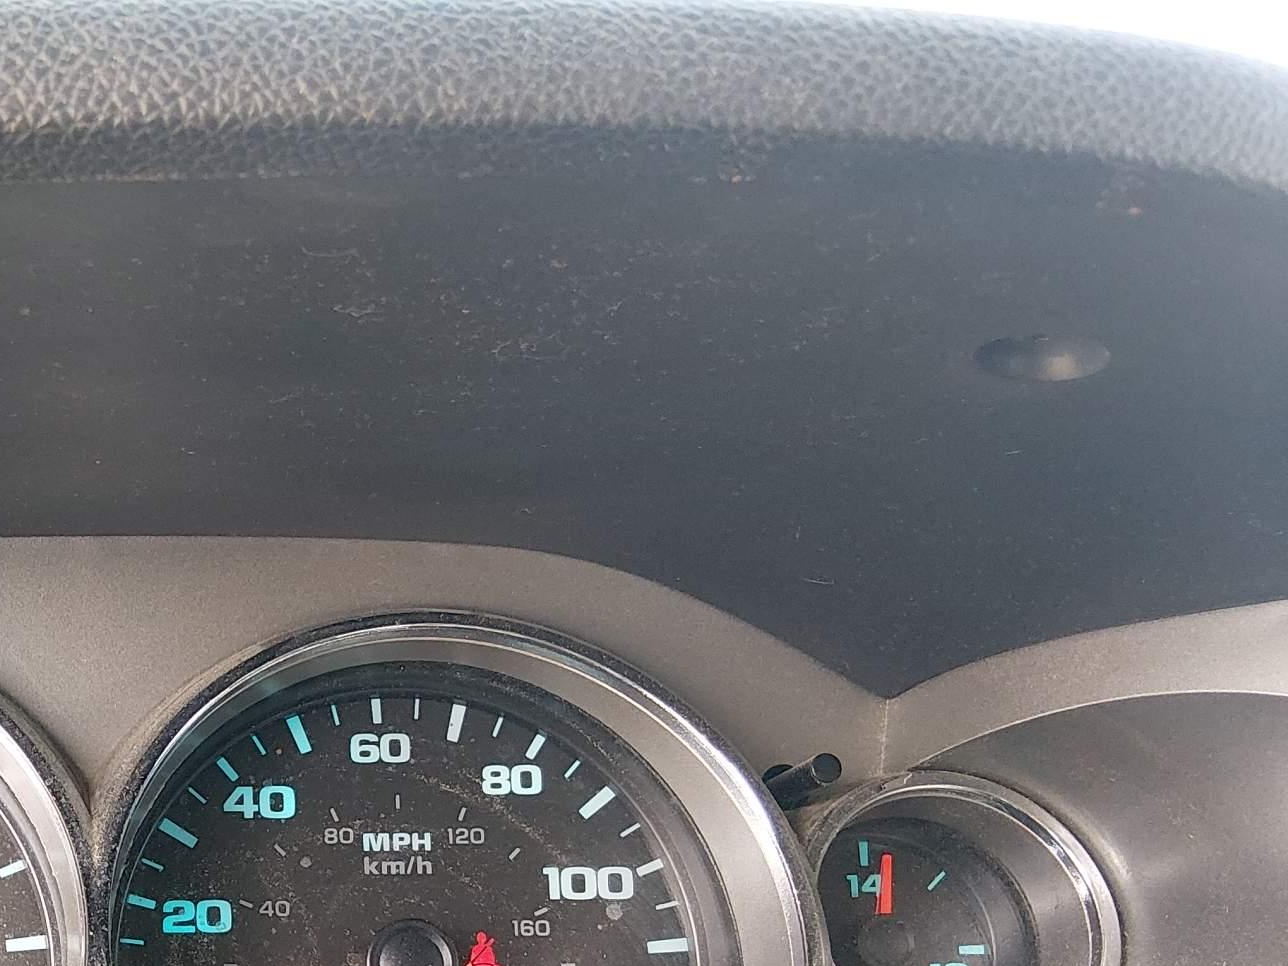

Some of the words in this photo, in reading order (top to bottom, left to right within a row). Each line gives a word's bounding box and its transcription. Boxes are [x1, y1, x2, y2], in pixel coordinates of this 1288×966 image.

[351, 734, 411, 763] 60
[482, 765, 542, 795] 80
[224, 786, 295, 818] 40
[325, 828, 353, 844] 80
[363, 833, 431, 851] MPH
[448, 828, 484, 844] 120
[364, 856, 432, 874] km/h
[543, 867, 633, 900] 100
[163, 900, 232, 933] 20
[260, 901, 290, 916] 40
[512, 920, 550, 936] 160
